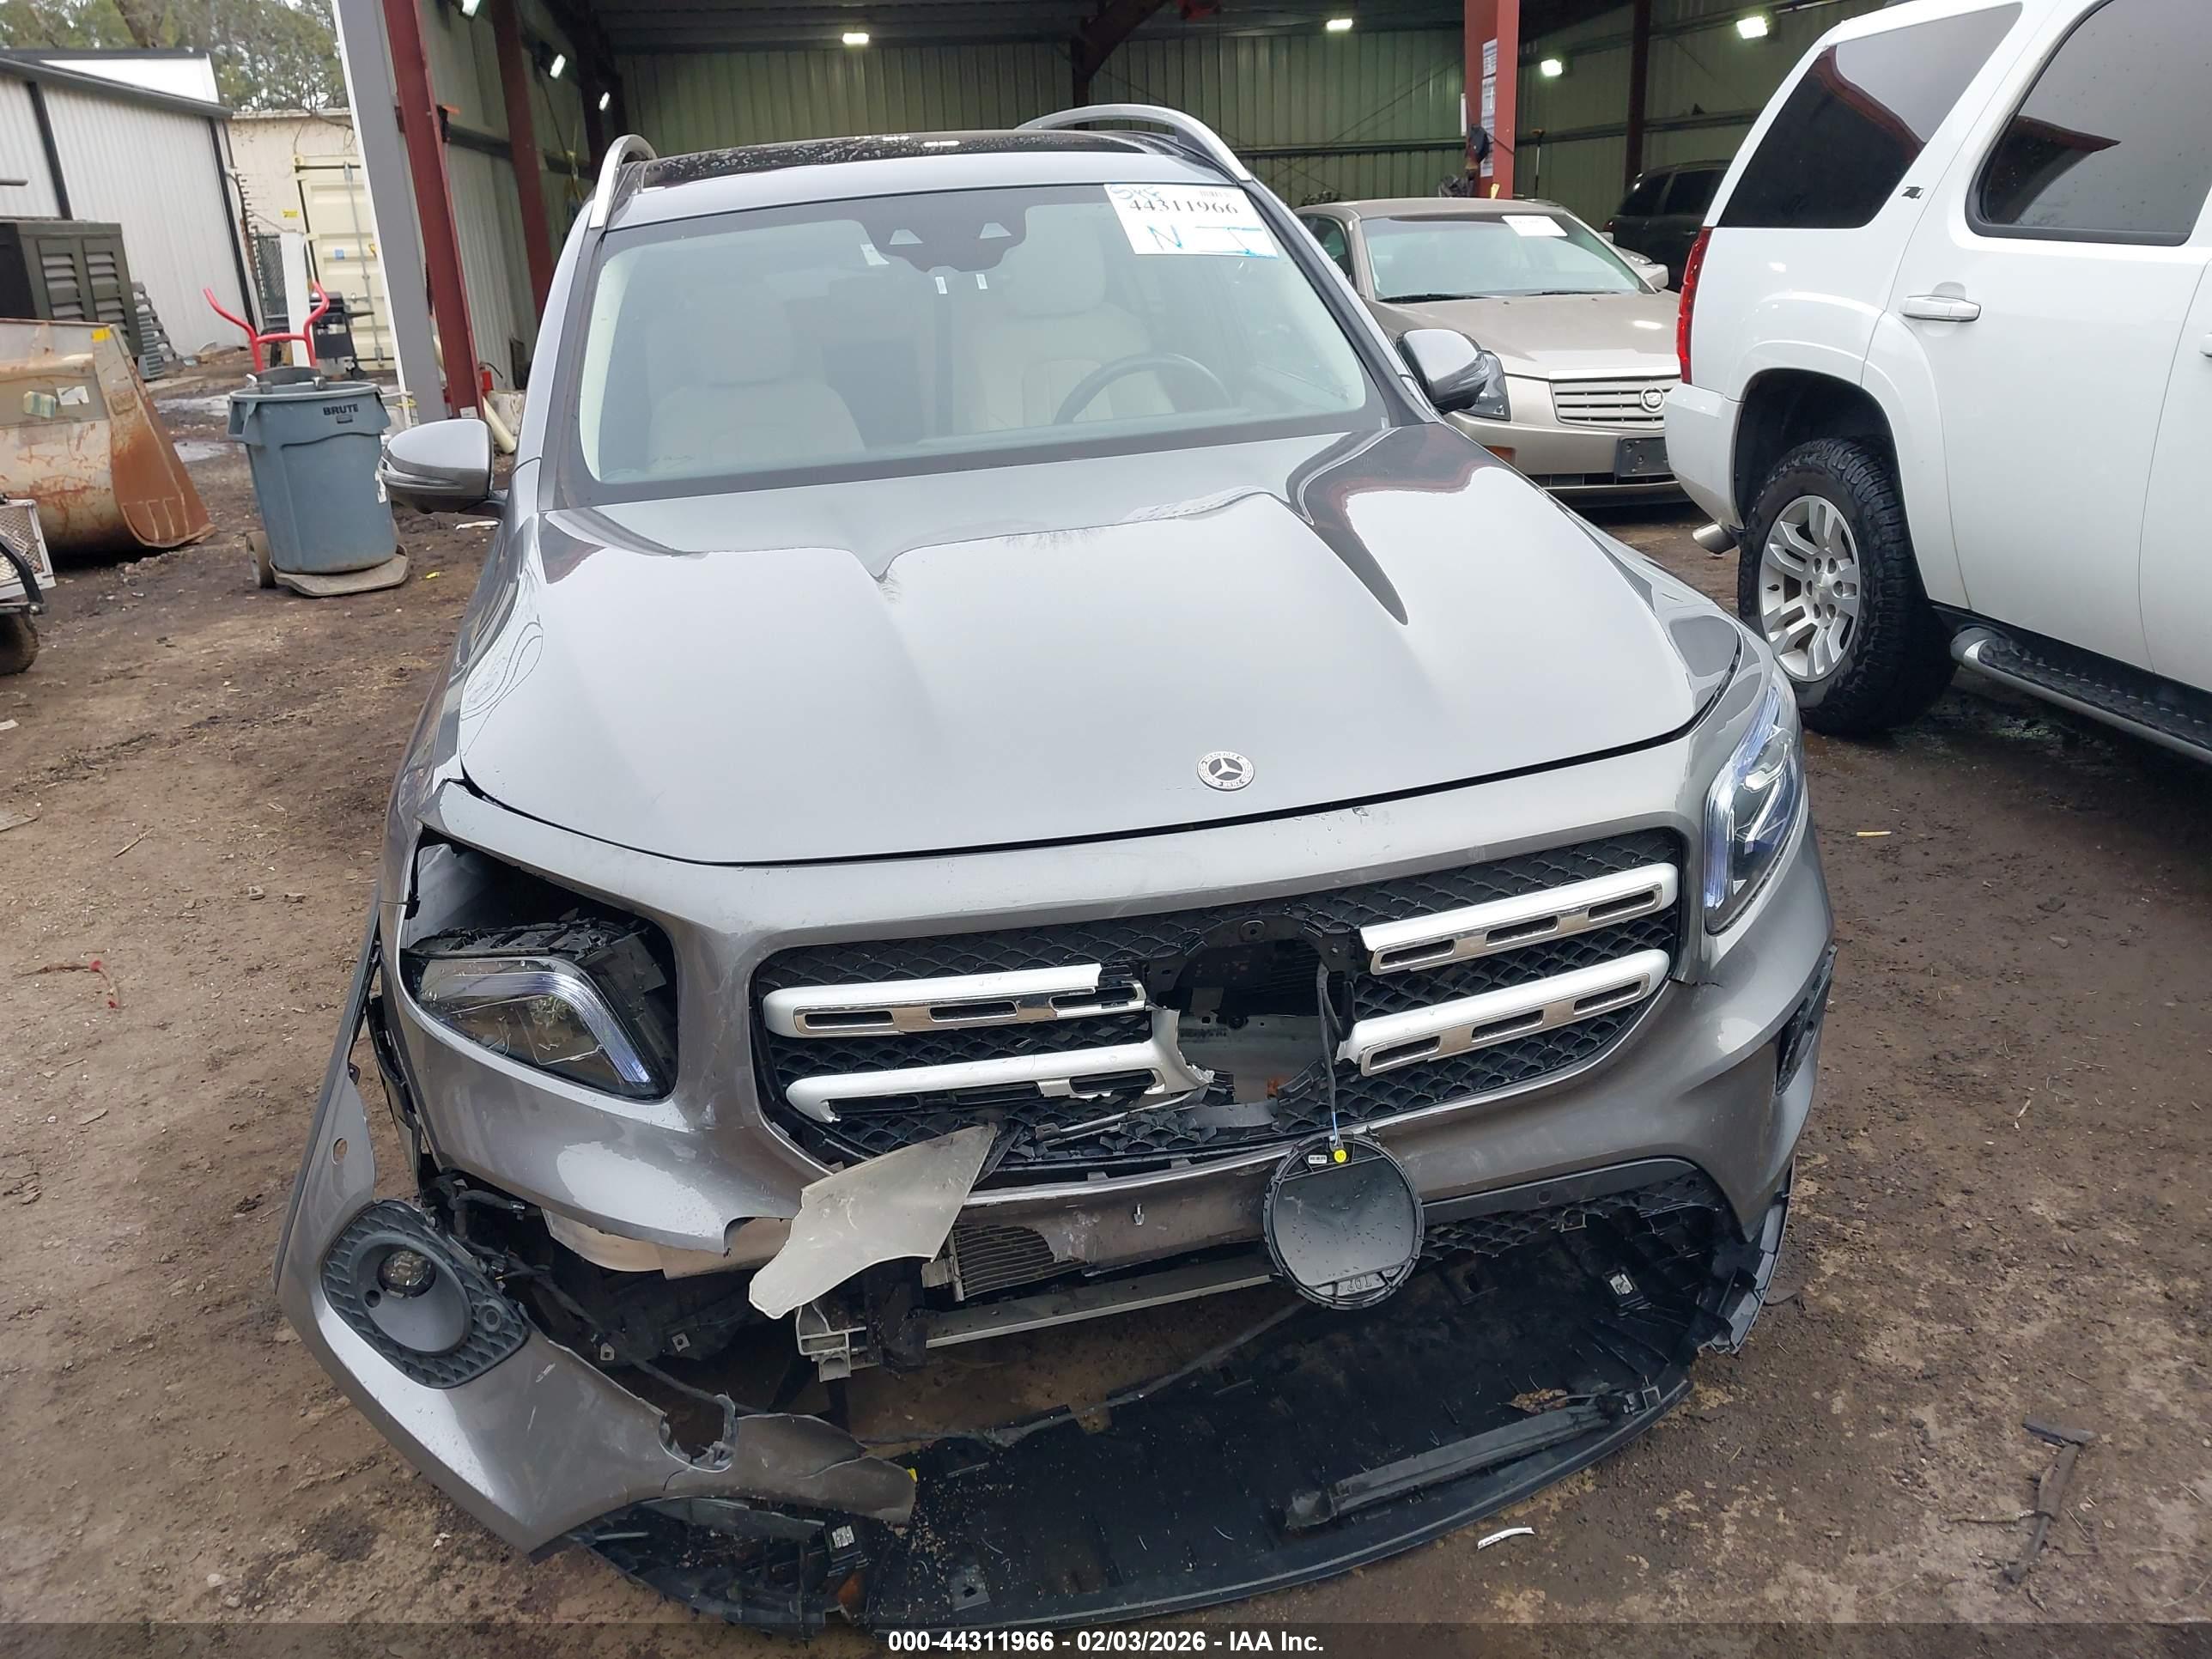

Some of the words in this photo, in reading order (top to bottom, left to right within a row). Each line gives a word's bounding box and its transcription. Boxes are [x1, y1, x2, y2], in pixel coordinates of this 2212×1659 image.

[1128, 199, 1239, 214] 44311966
[1146, 225, 1183, 251] N
[323, 404, 359, 416] BRUTE
